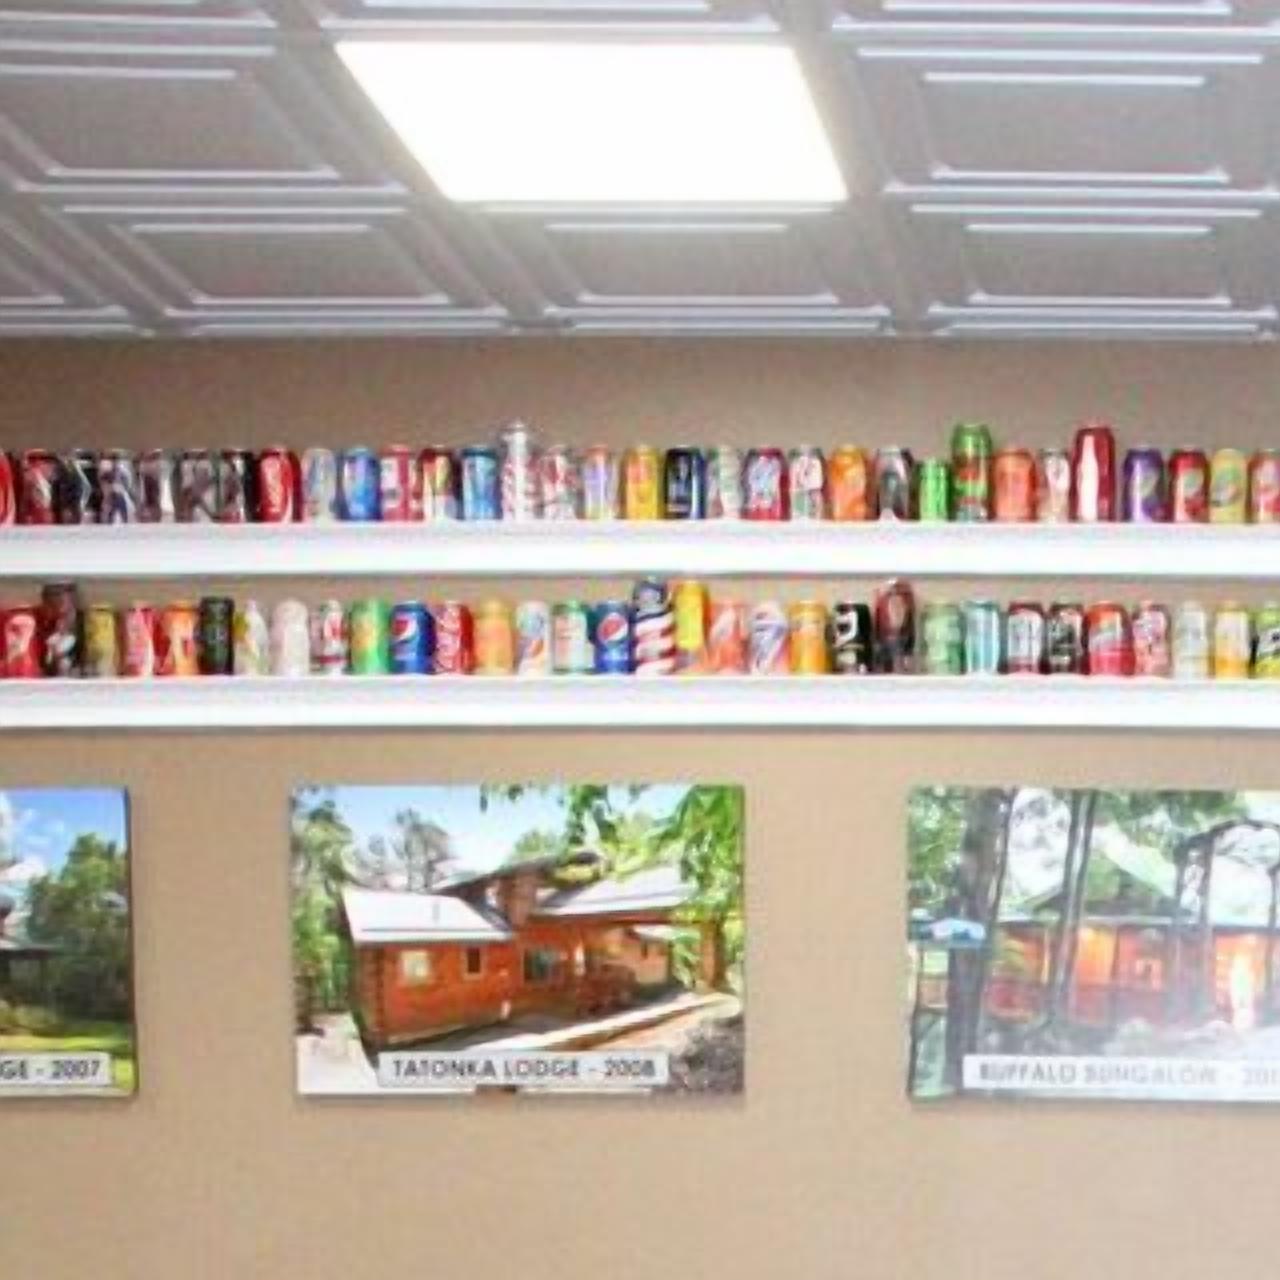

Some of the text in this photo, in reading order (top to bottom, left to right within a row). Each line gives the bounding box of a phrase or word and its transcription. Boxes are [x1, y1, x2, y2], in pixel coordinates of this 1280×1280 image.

[51, 1059, 99, 1080] 2007
[392, 1059, 497, 1077] TATONKA
[502, 1060, 580, 1077] LODGE
[980, 1061, 1077, 1084] BUFFALO
[1084, 1062, 1217, 1084] BUNGALOW
